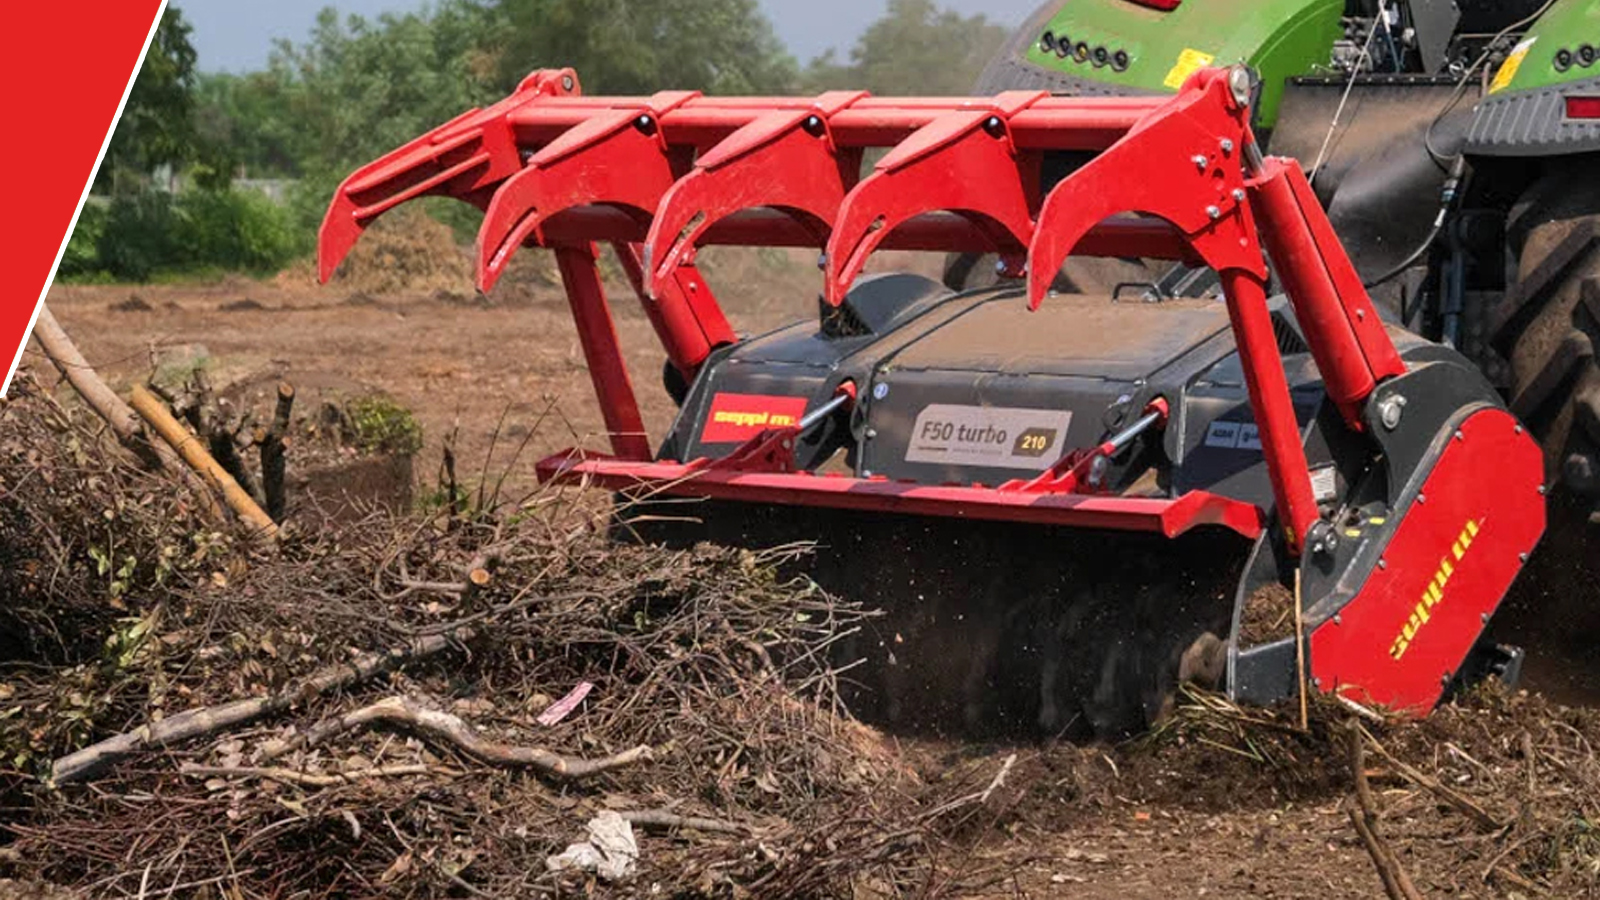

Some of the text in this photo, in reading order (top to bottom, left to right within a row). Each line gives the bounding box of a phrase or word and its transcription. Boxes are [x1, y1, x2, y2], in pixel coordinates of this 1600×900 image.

[921, 420, 1007, 445] F50 turbo
[1021, 434, 1047, 450] 210
[1389, 557, 1454, 661] seppi
